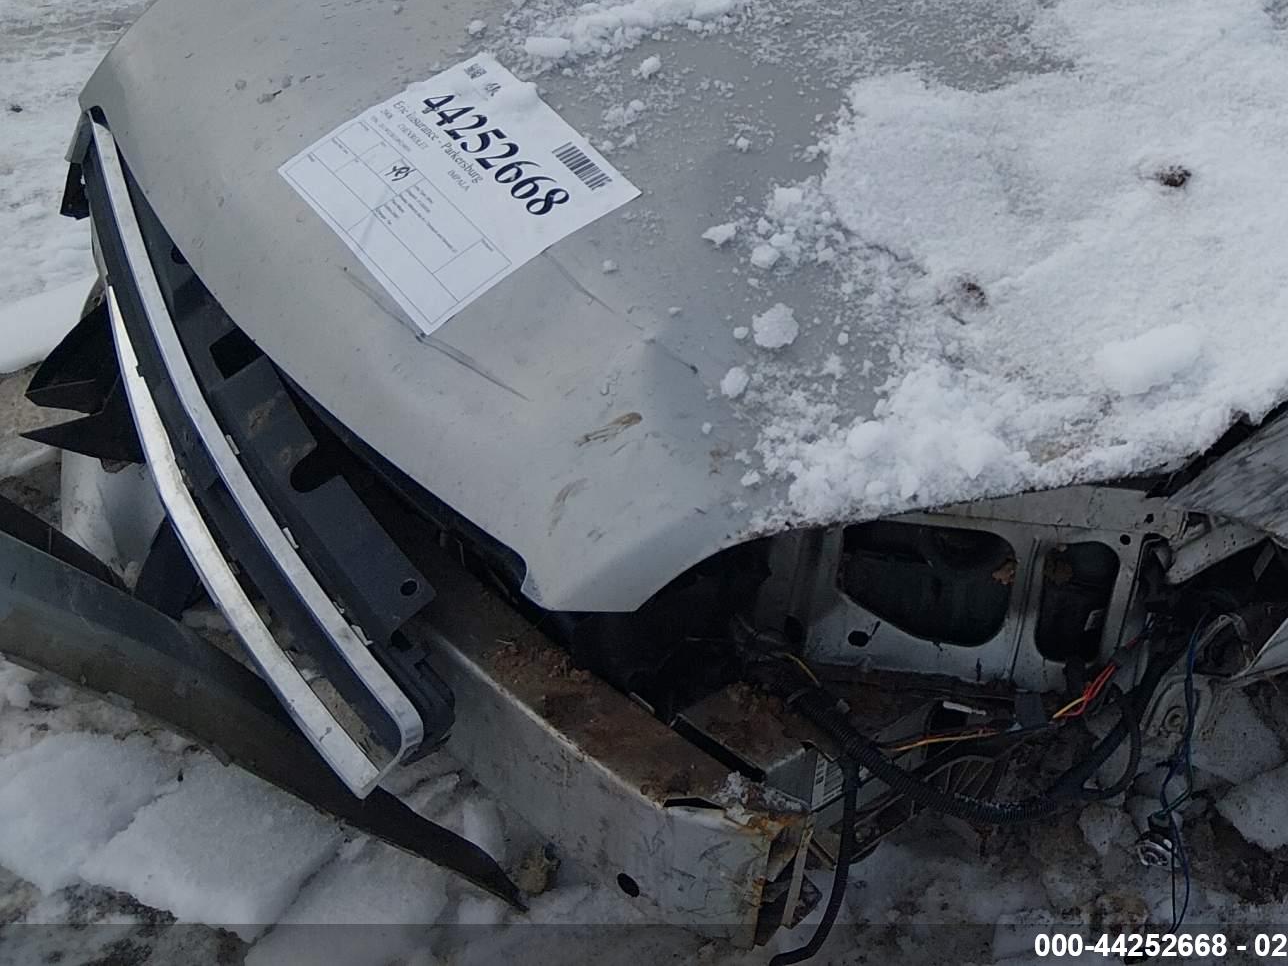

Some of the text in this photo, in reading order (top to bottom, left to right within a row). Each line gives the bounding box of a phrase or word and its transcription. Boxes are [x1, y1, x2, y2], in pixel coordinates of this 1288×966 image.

[405, 110, 440, 141] Insurance
[439, 141, 483, 185] Parkersburg
[422, 94, 570, 216] 44252668
[447, 169, 471, 192] IMPALA
